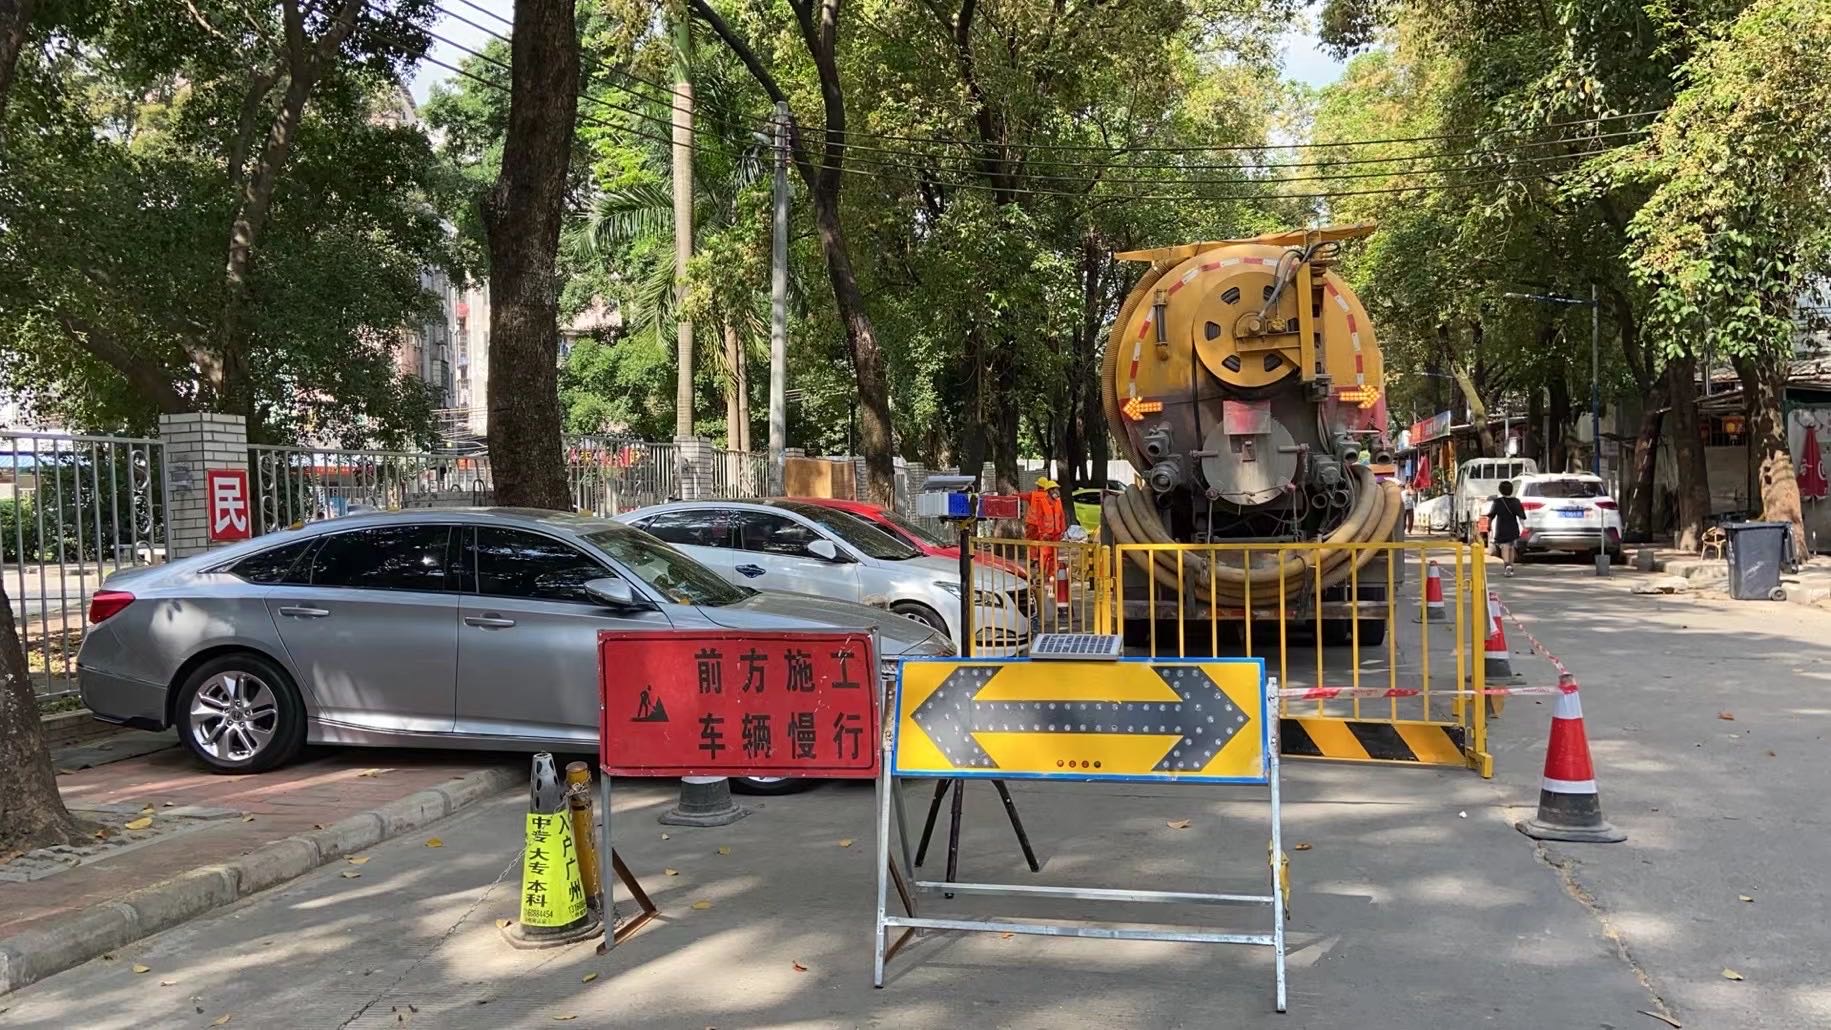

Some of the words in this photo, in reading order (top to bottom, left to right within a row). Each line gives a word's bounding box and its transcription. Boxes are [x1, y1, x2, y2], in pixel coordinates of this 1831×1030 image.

[213, 477, 247, 534] 民
[694, 647, 861, 694] 前方施工
[698, 712, 864, 760] 车辆慢行
[558, 815, 582, 902] 入户广州
